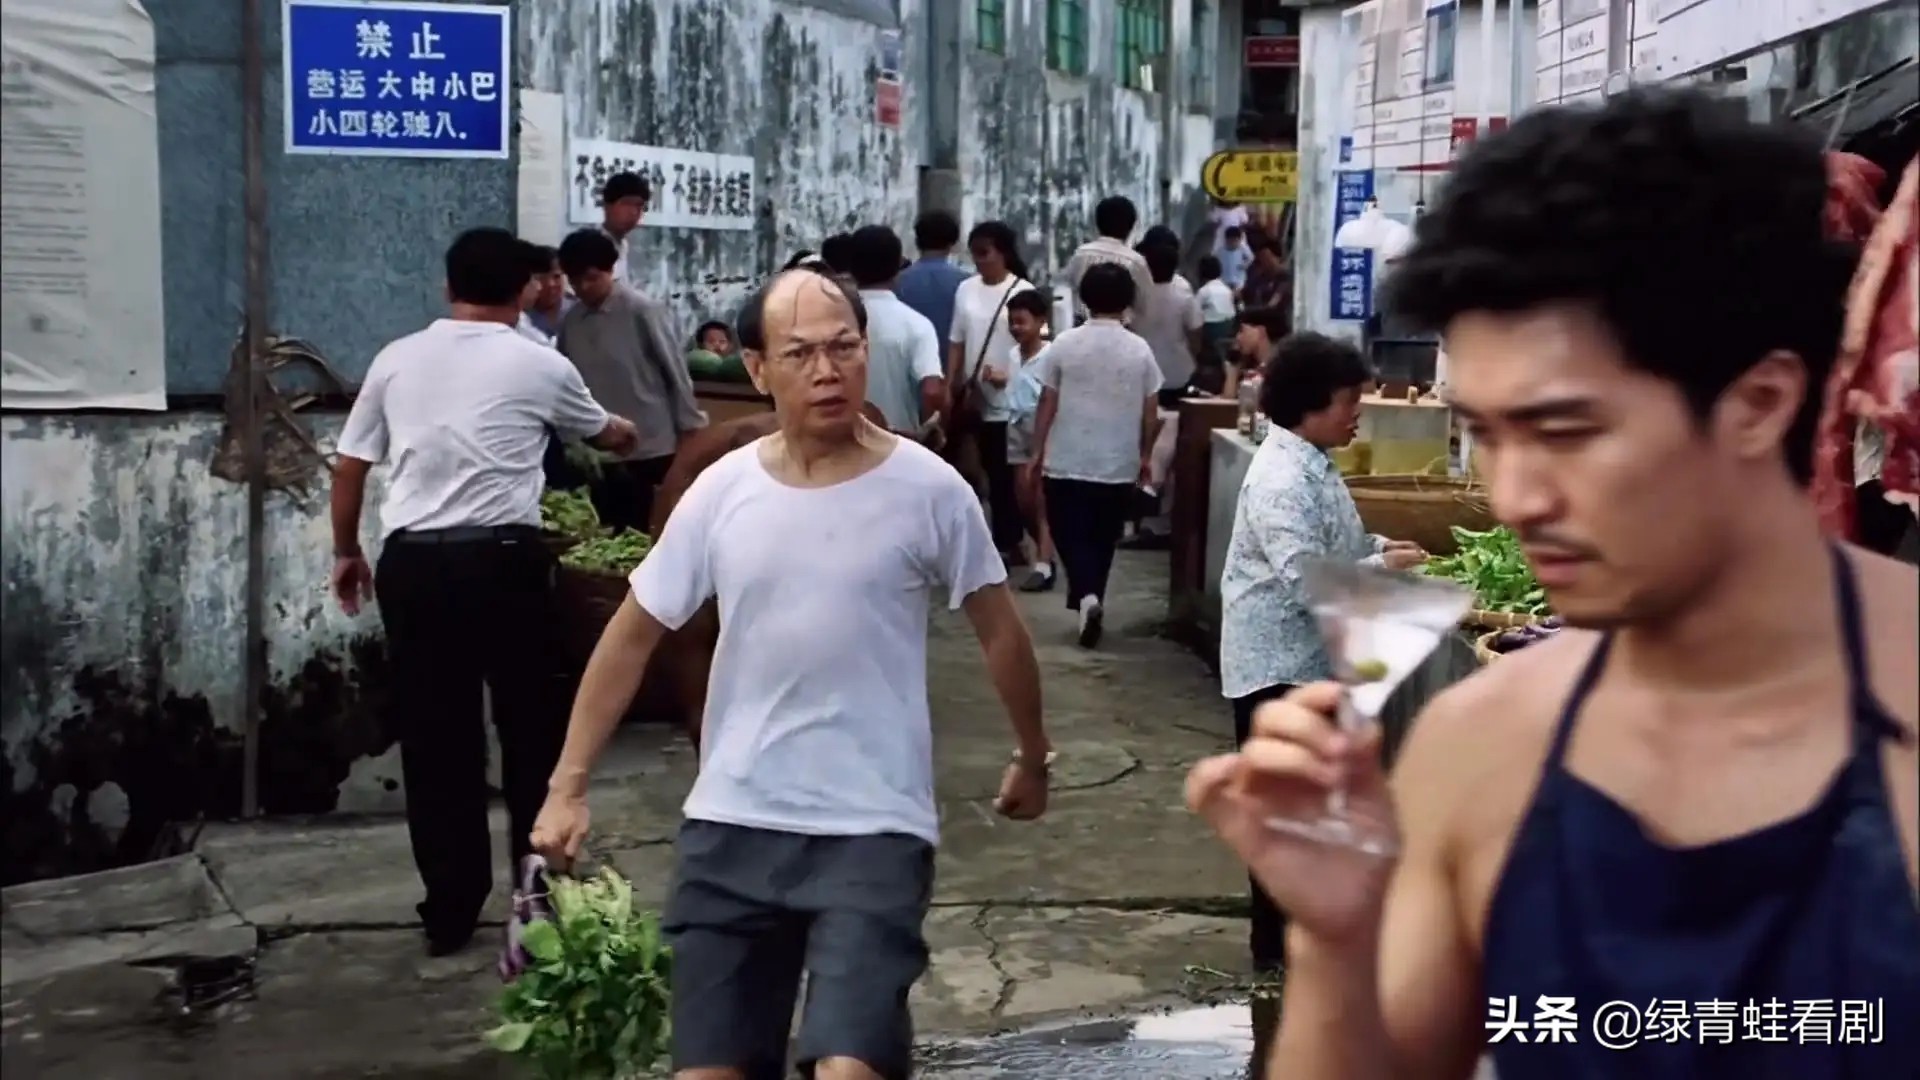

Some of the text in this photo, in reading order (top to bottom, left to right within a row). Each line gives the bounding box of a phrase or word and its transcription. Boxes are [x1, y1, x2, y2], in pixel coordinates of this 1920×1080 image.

[356, 19, 446, 59] 禁止
[307, 68, 497, 102] 营运大中小巴
